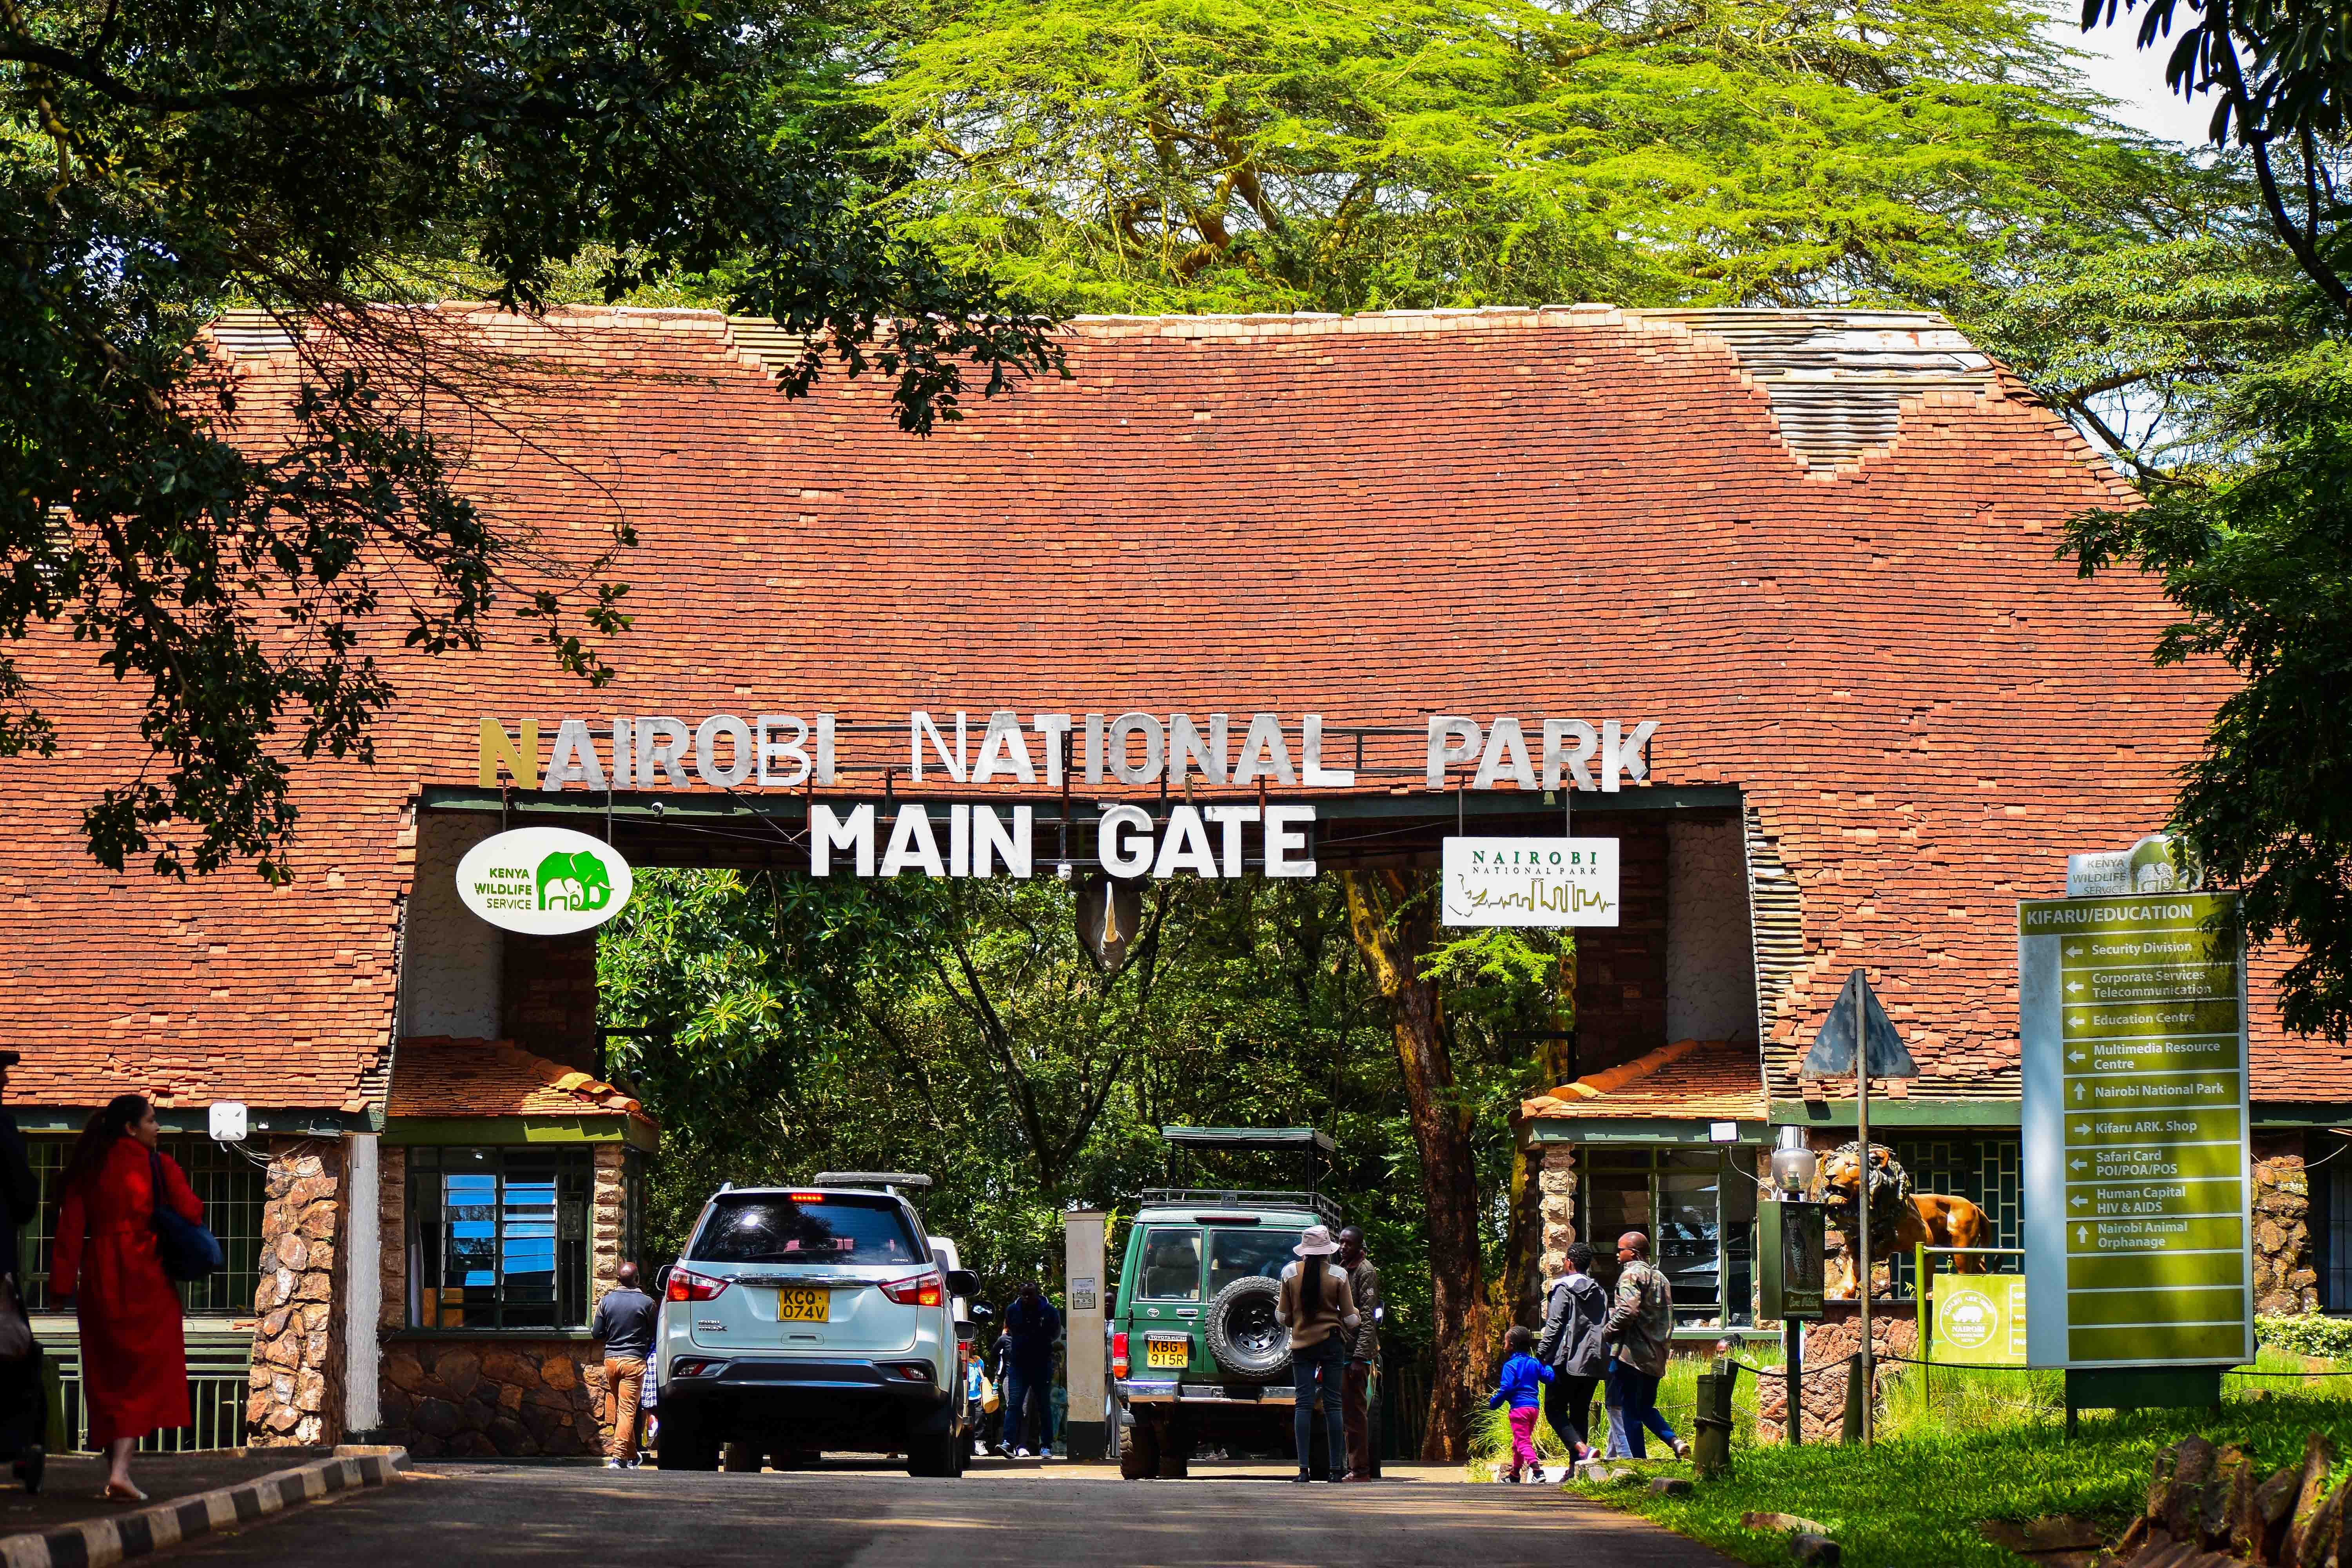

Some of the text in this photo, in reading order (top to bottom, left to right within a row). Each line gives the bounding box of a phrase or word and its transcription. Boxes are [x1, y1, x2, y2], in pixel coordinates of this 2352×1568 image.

[479, 711, 1661, 792] NAIROBI NATIONAL PARK
[811, 804, 1316, 878] MAIN GATE
[1472, 851, 1597, 864] NAIROBI
[2087, 858, 2124, 868] KENYA
[490, 868, 530, 879] KENYA
[2073, 872, 2126, 883] WILDLIFE
[474, 883, 532, 895] WILDLIFE
[2084, 885, 2125, 895] SERVICE
[487, 898, 531, 909] SERVICE
[2027, 904, 2193, 925] KIFARU/EDUCATION
[2092, 941, 2192, 956] Security Division
[2092, 969, 2205, 985] Corporate Services
[2092, 984, 2211, 998] Telecommunication
[2093, 1012, 2196, 1025] Education Centre
[2094, 1042, 2221, 1055] Multimedia Resource
[2094, 1059, 2134, 1070] Centre
[2095, 1082, 2224, 1097] Nairobi National Park
[2096, 1120, 2197, 1134] Kifaru ARK. Shop
[2096, 1150, 2161, 1162] Safari Card
[2097, 1163, 2177, 1176] POI/POA/POS
[2097, 1186, 2186, 1199] Human Capital
[2098, 1202, 2162, 1213] HIV & AIDS
[2098, 1221, 2187, 1234] Nairobi Animal
[2098, 1237, 2165, 1249] Orphanage
[784, 1290, 815, 1305] KCQ
[783, 1305, 825, 1319] 074V
[1218, 1303, 1230, 1347] COOPER
[1153, 1341, 1178, 1352] KBG
[1151, 1354, 1185, 1365] 915R
